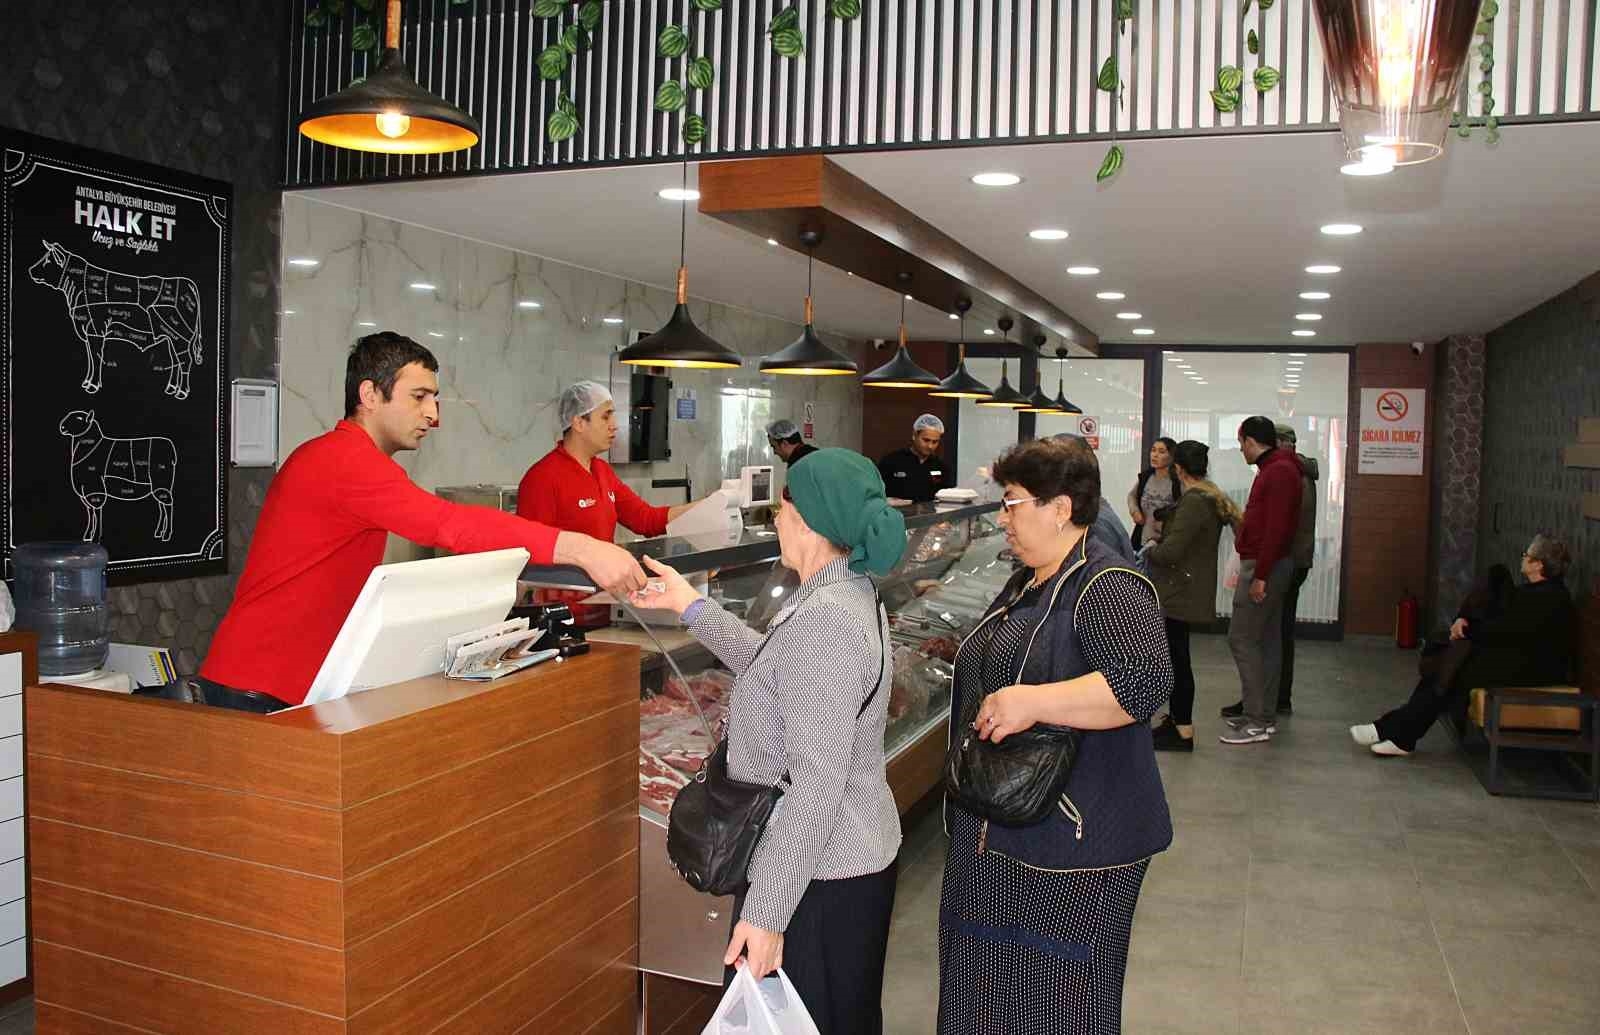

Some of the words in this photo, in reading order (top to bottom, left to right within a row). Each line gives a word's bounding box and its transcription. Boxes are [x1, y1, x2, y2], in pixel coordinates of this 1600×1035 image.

[75, 185, 104, 201] ANTALYA
[75, 200, 143, 236] HALK
[151, 214, 176, 241] ET
[92, 230, 114, 249] Ucuz
[115, 237, 125, 247] ve
